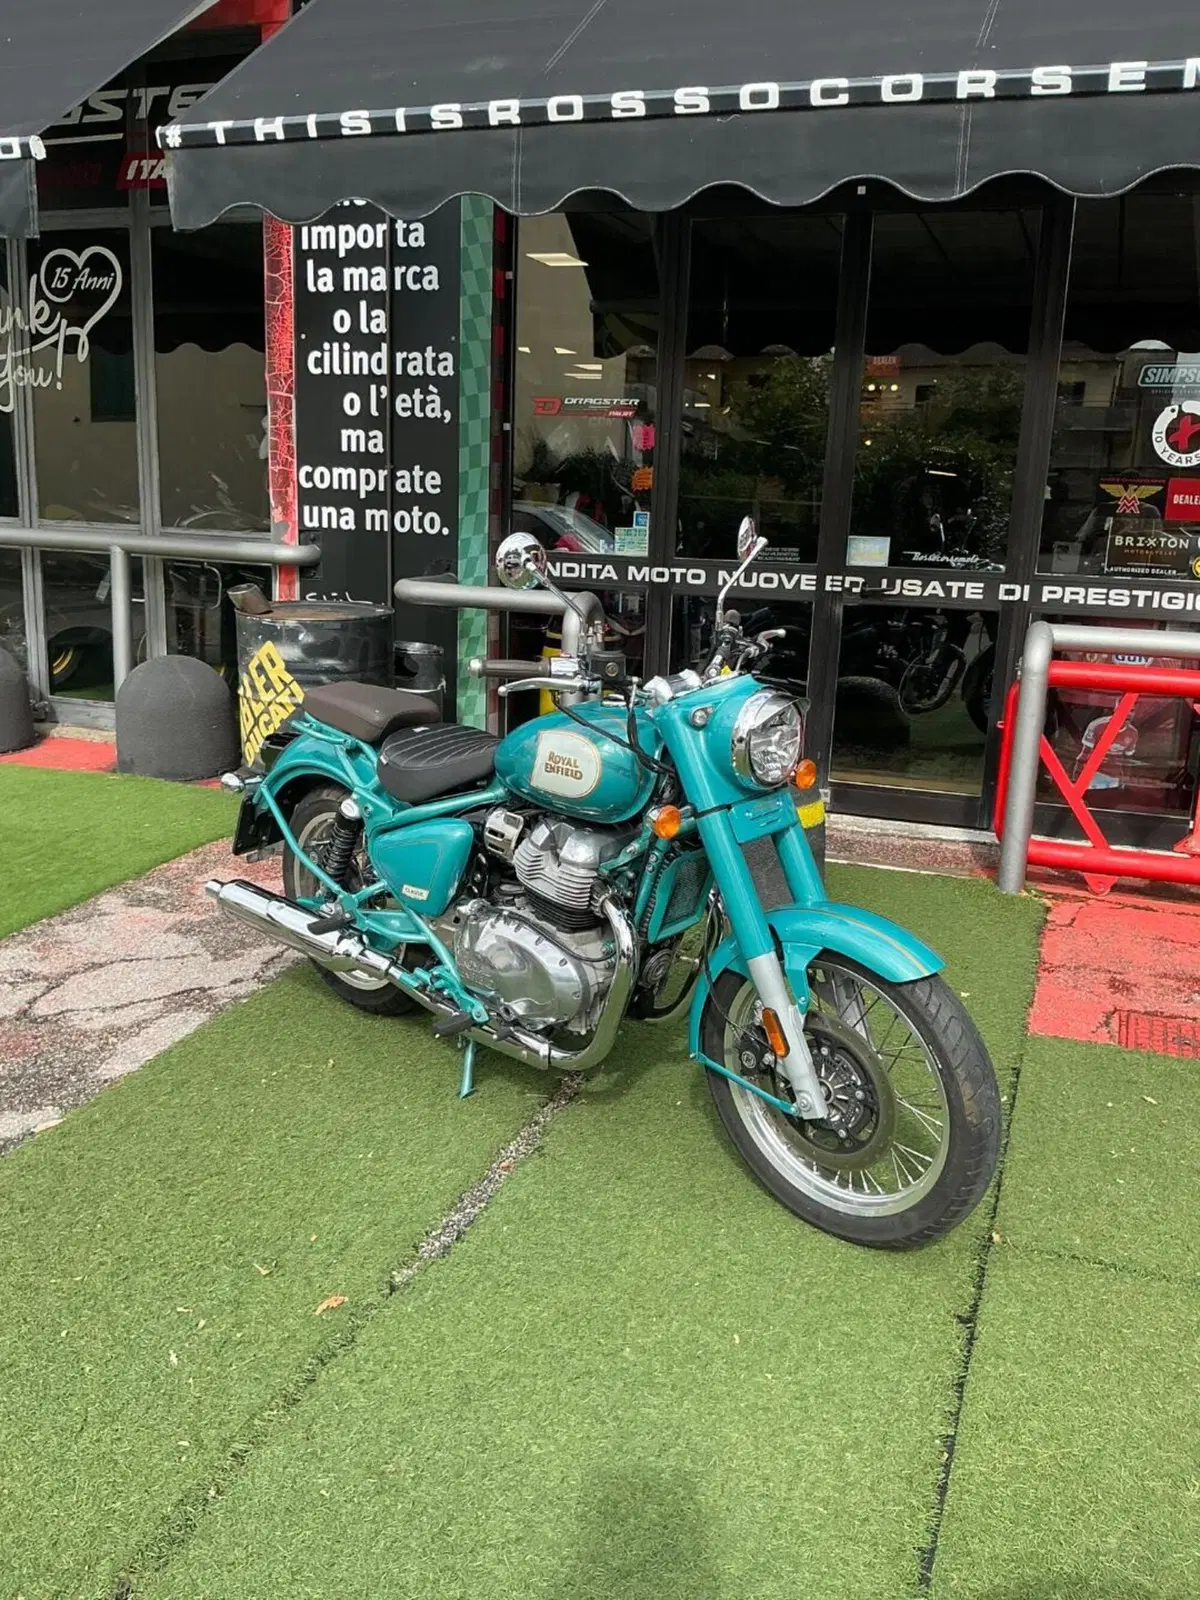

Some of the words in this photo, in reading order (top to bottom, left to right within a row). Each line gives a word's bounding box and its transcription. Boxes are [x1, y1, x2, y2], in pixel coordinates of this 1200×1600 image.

[51, 267, 71, 289] 15
[73, 267, 115, 290] Anni
[306, 259, 335, 293] la
[343, 264, 440, 292] marca
[332, 308, 352, 334] o
[360, 300, 388, 334] la
[307, 341, 455, 377] cilindrata
[342, 391, 361, 417] o
[564, 397, 641, 406] DRAGSTER
[340, 427, 385, 454] ma
[298, 464, 442, 500] comprate
[1172, 493, 1200, 506] DEALE
[302, 504, 356, 531] una
[364, 505, 450, 536] moto.
[1151, 567, 1178, 576] DEALER
[543, 561, 619, 582] NDITA
[627, 564, 707, 586] MOTO
[717, 569, 817, 592] NUOVE
[881, 578, 984, 600] USATE
[997, 583, 1030, 602] DI
[1041, 585, 1200, 612] PRESTIGI
[544, 762, 584, 781] ENFIELD
[548, 751, 580, 769] ROYAL
